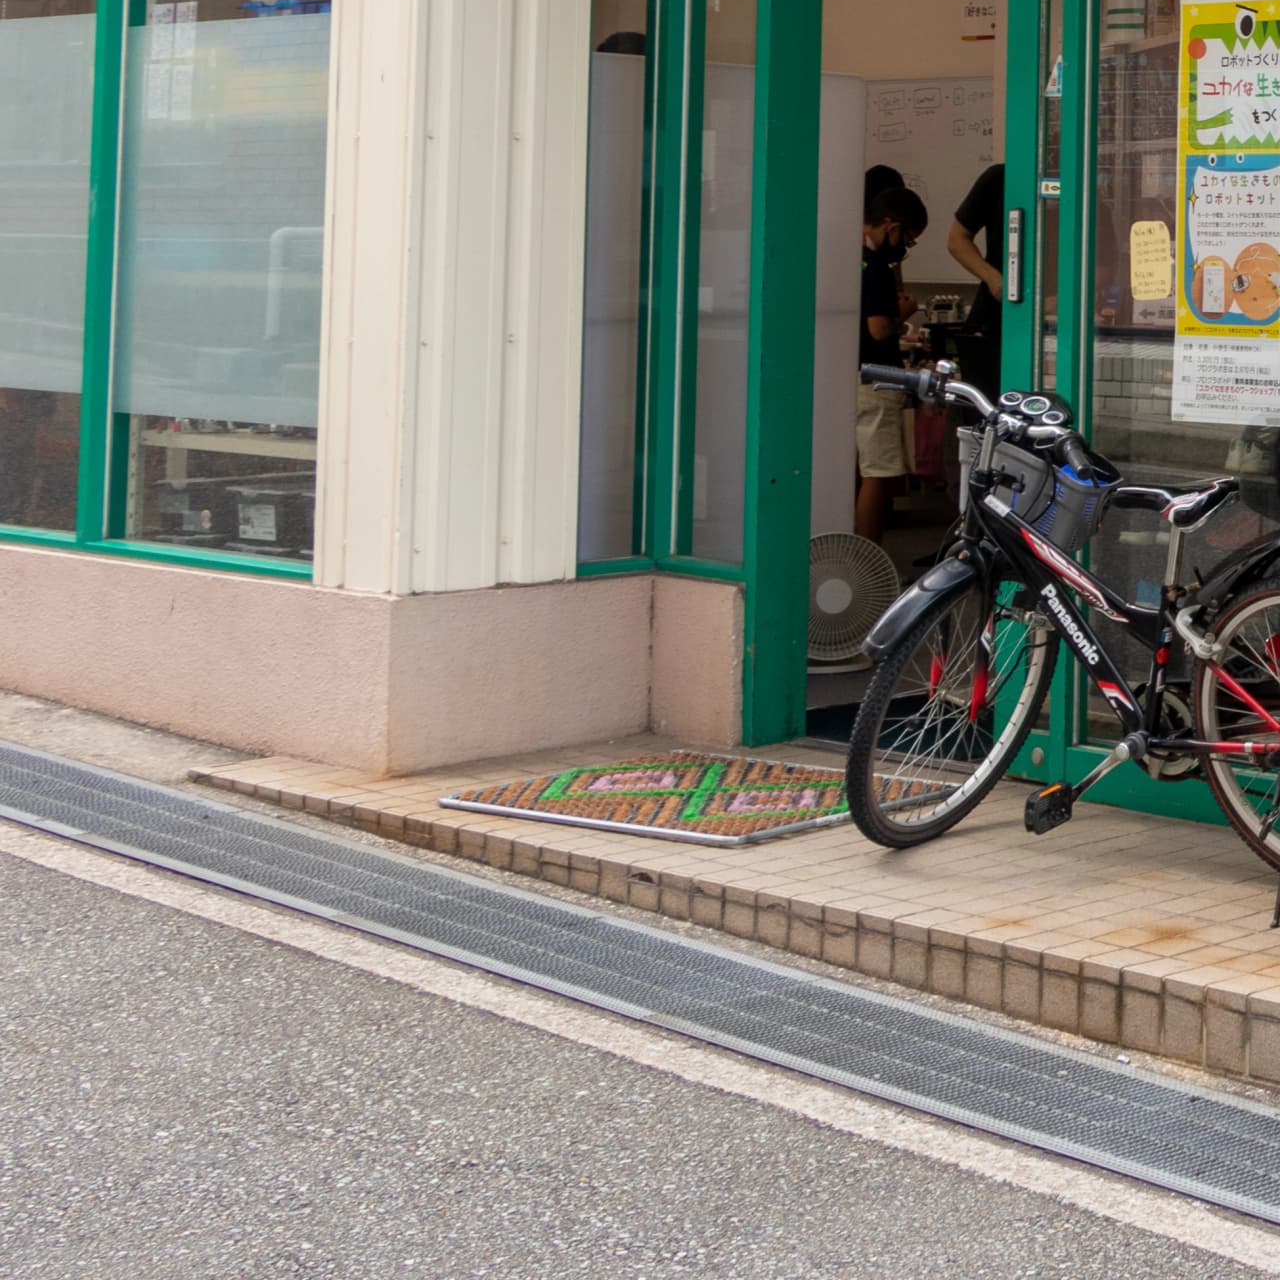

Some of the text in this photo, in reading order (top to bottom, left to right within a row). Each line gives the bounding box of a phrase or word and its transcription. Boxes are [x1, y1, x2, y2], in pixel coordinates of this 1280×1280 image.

[1205, 193, 1276, 206] ロボットキット
[1040, 582, 1100, 667] Panasonic
